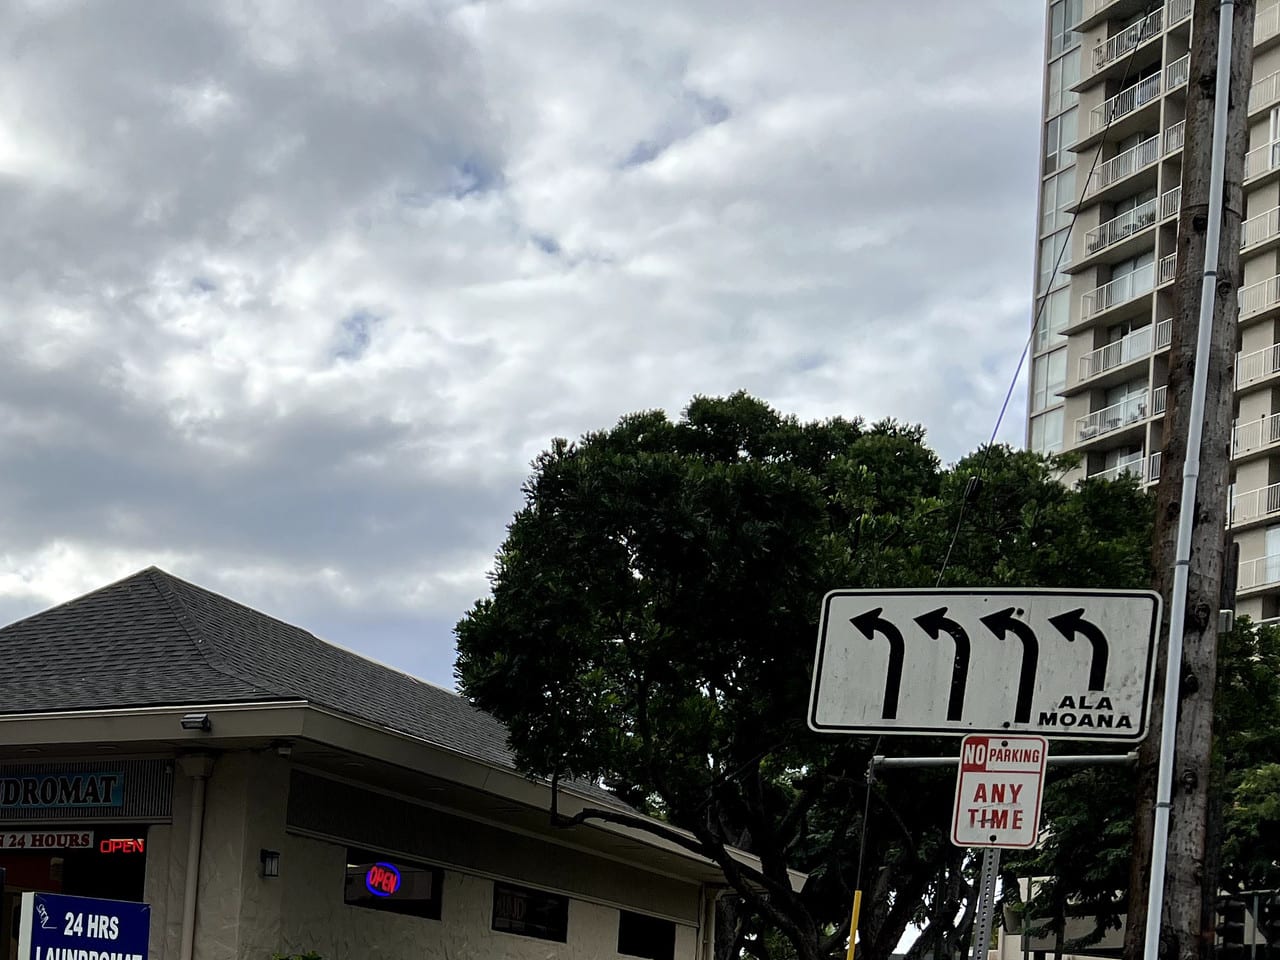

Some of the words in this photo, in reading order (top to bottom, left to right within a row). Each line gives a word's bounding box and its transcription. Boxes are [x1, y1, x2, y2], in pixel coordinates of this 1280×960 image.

[1058, 695, 1113, 711] ALA
[1038, 712, 1133, 729] MOANA
[963, 743, 987, 765] NO
[988, 748, 1040, 764] PARKING
[973, 783, 1023, 804] ANY
[968, 809, 1023, 830] TIME
[8, 833, 26, 850] 24
[31, 832, 90, 849] HOURS
[99, 838, 145, 854] OPEN
[369, 866, 397, 894] OPEN
[63, 911, 83, 937] 24
[87, 914, 119, 940] HRS
